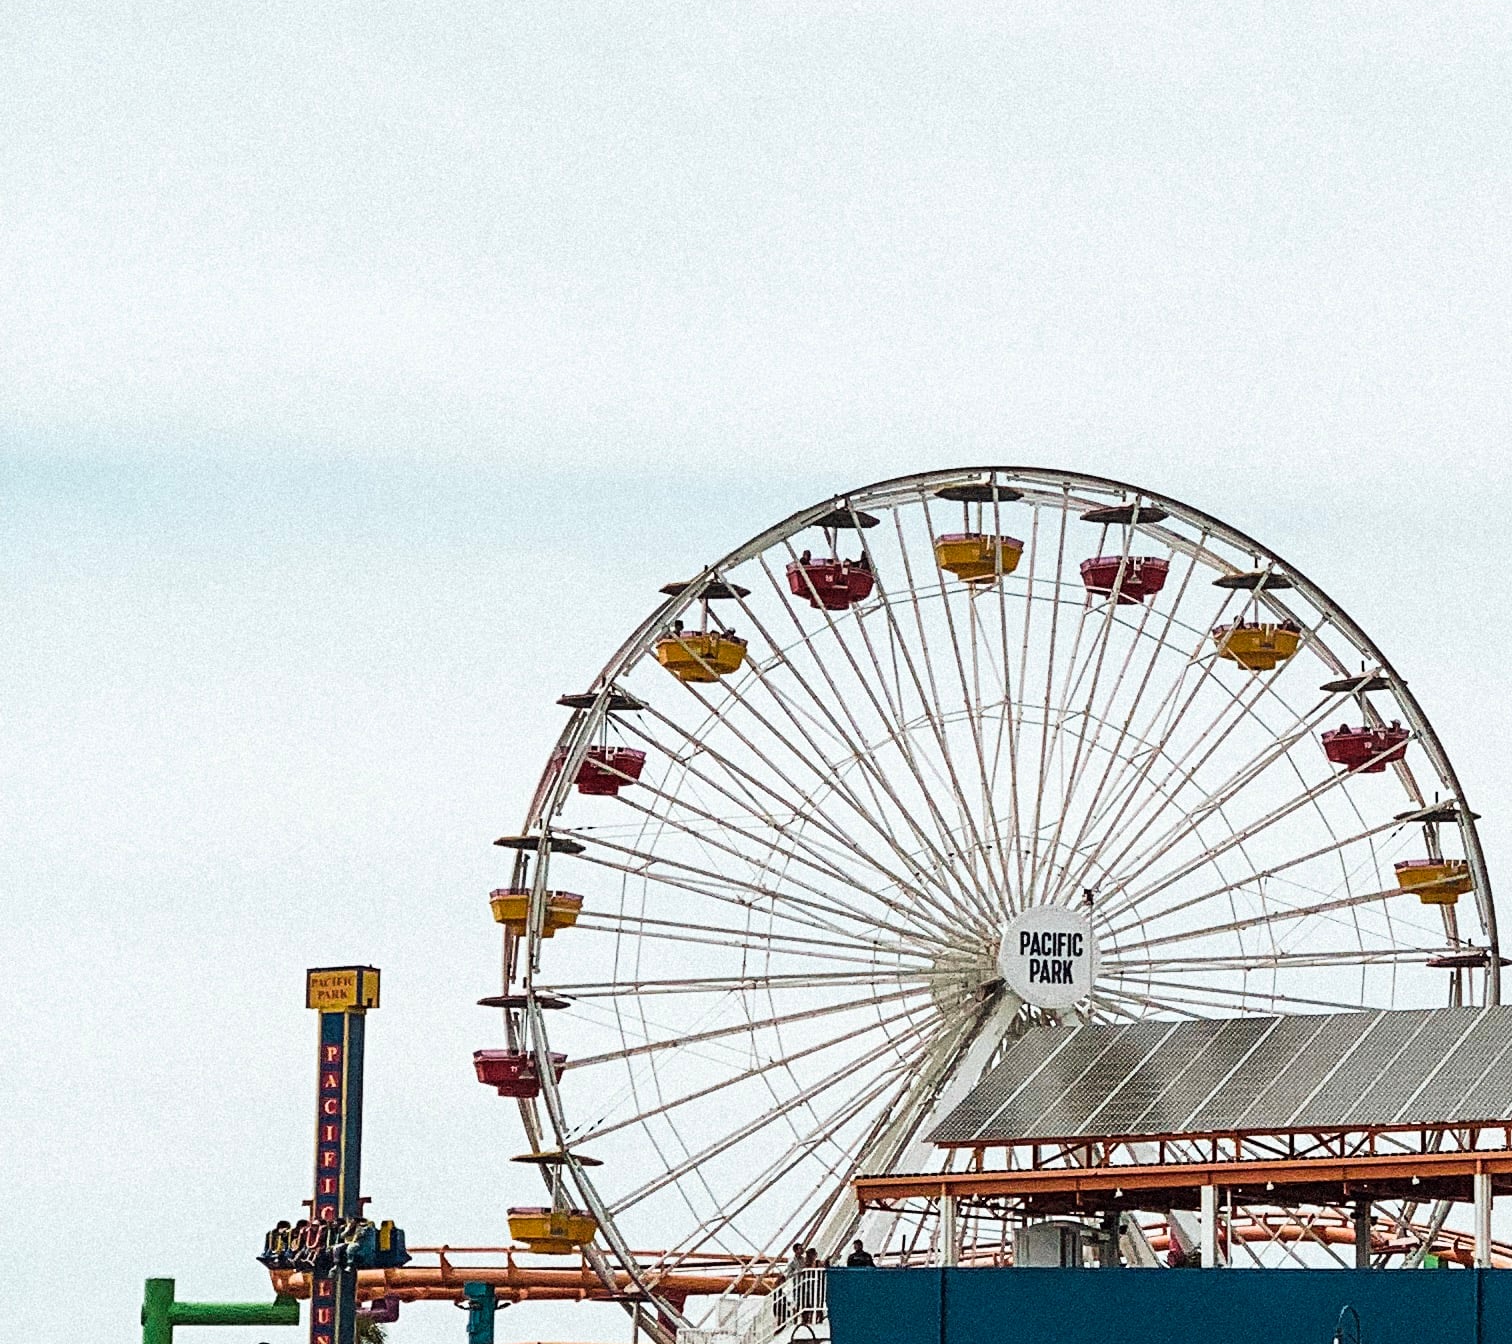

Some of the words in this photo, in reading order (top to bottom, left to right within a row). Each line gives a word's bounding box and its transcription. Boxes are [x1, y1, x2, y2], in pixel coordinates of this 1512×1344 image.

[1020, 931, 1083, 957] PACIFIC
[1030, 959, 1073, 984] PARK
[318, 990, 348, 1000] PARK
[320, 1046, 338, 1222] PACIFIC
